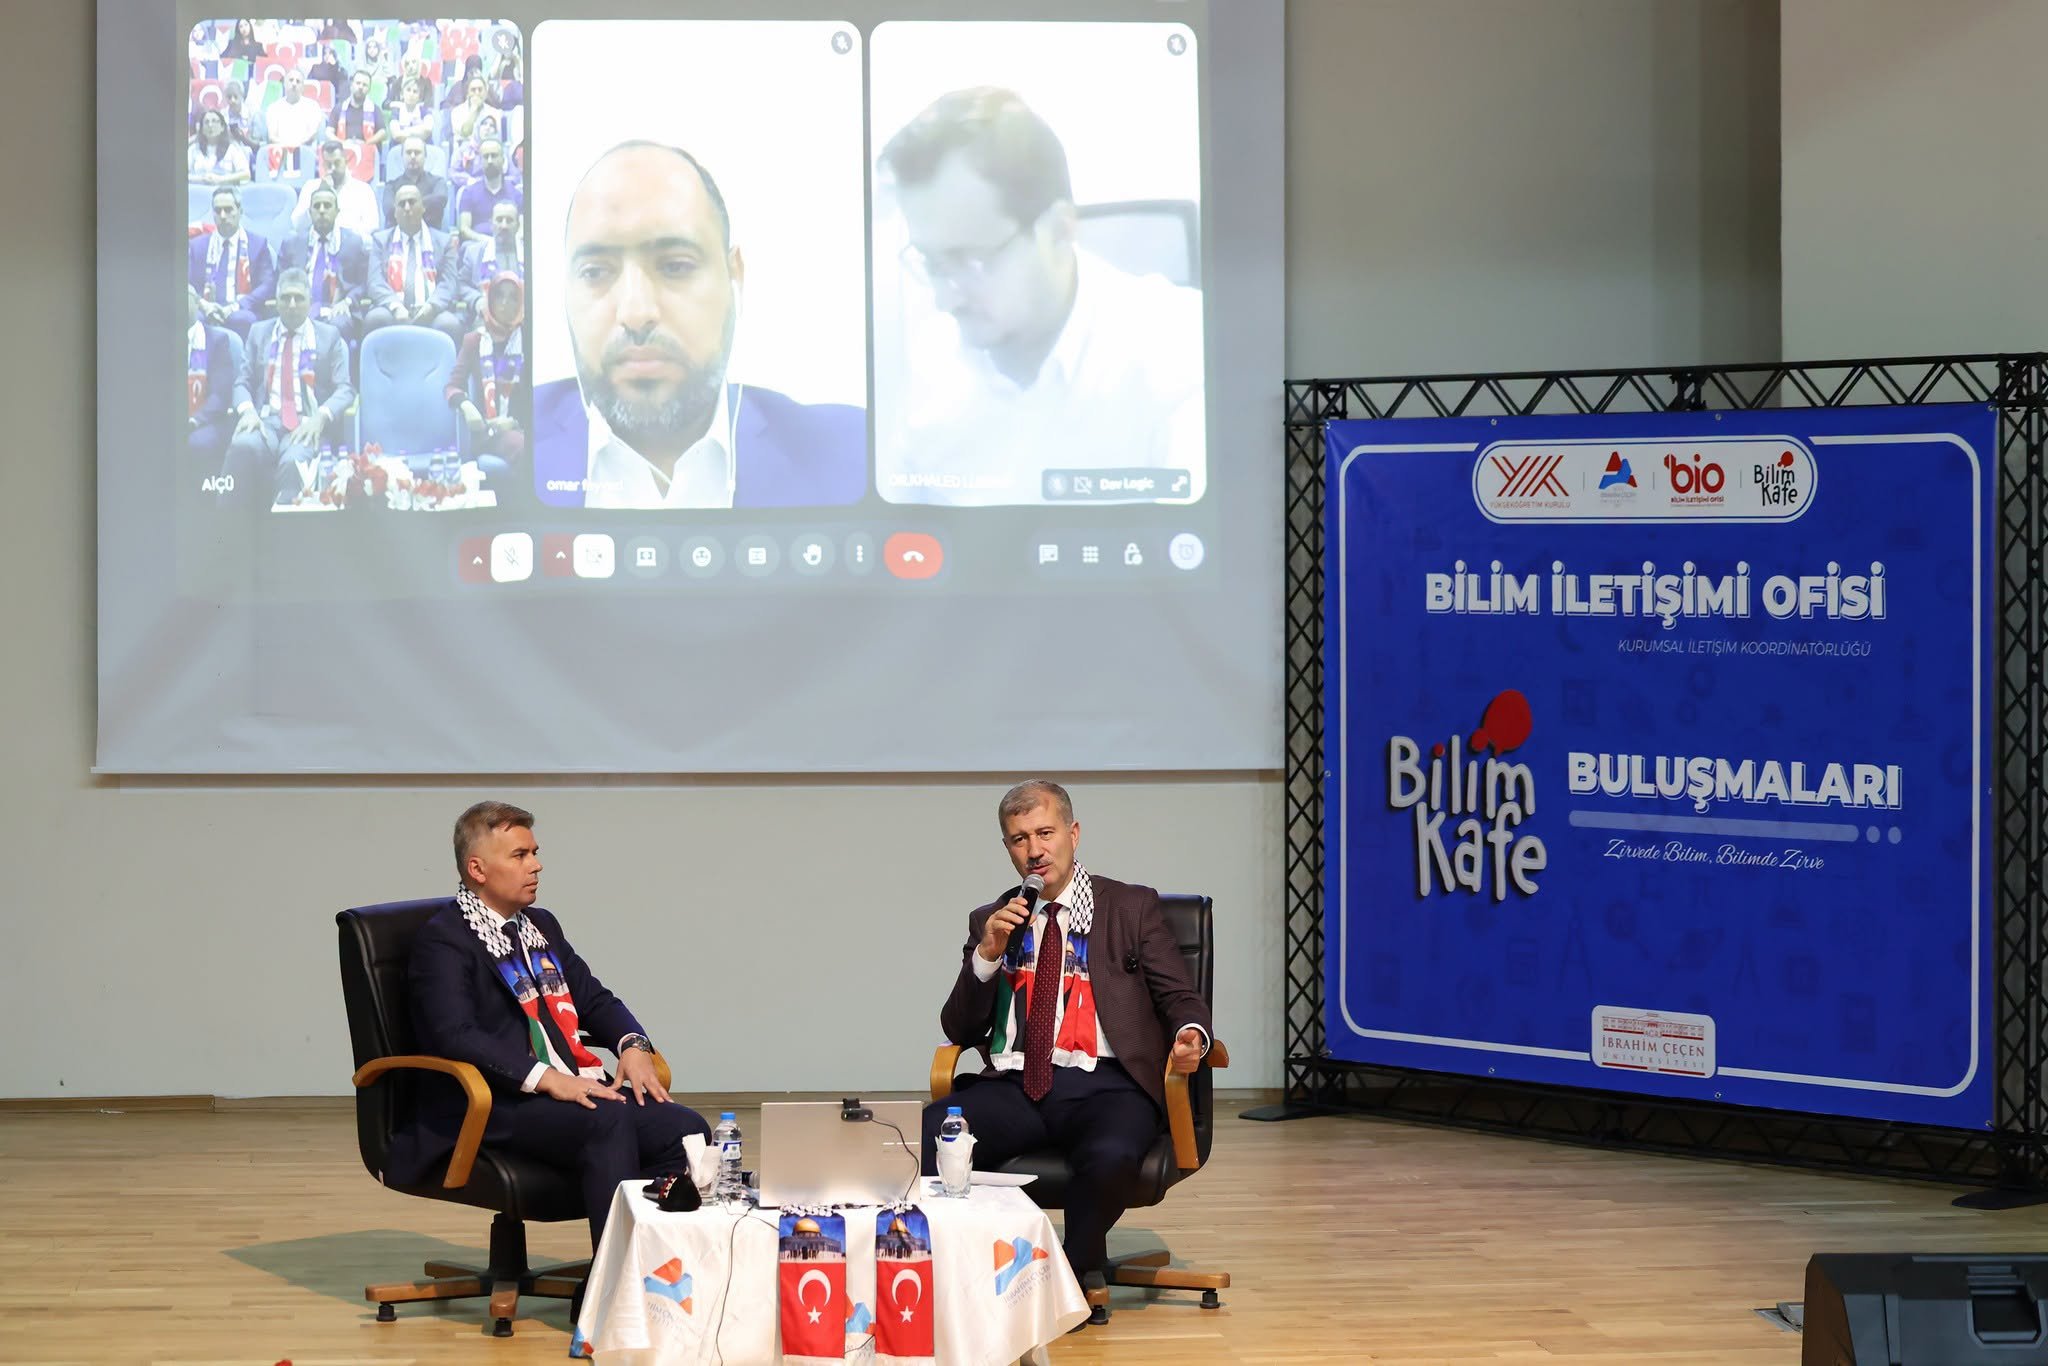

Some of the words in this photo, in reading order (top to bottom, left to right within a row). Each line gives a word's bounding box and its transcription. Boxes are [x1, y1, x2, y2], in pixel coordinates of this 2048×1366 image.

[1664, 453, 1725, 494] bio
[1754, 462, 1796, 485] Bilim
[1761, 479, 1799, 507] Kafe
[1425, 559, 1541, 617] BİLİM
[1552, 559, 1751, 630] İLETİŞİMİ
[1761, 560, 1887, 620] OFİSİ
[1618, 639, 1684, 653] KURUMSAL
[1688, 638, 1738, 657] İLETİŞİM
[1740, 640, 1872, 657] KOORDİNATÖRLÜĞÜ
[1388, 734, 1536, 820] Bilim
[1568, 751, 1903, 815] BULUŞMALARI
[1415, 800, 1548, 901] Kafe
[1603, 838, 1661, 860] Zirvede
[1663, 840, 1713, 865] Bilim,
[1715, 843, 1779, 867] Bilimde
[1779, 849, 1825, 871] Zirve
[1602, 1034, 1658, 1052] İBRAHİM
[1662, 1042, 1705, 1059] ÇEÇEN
